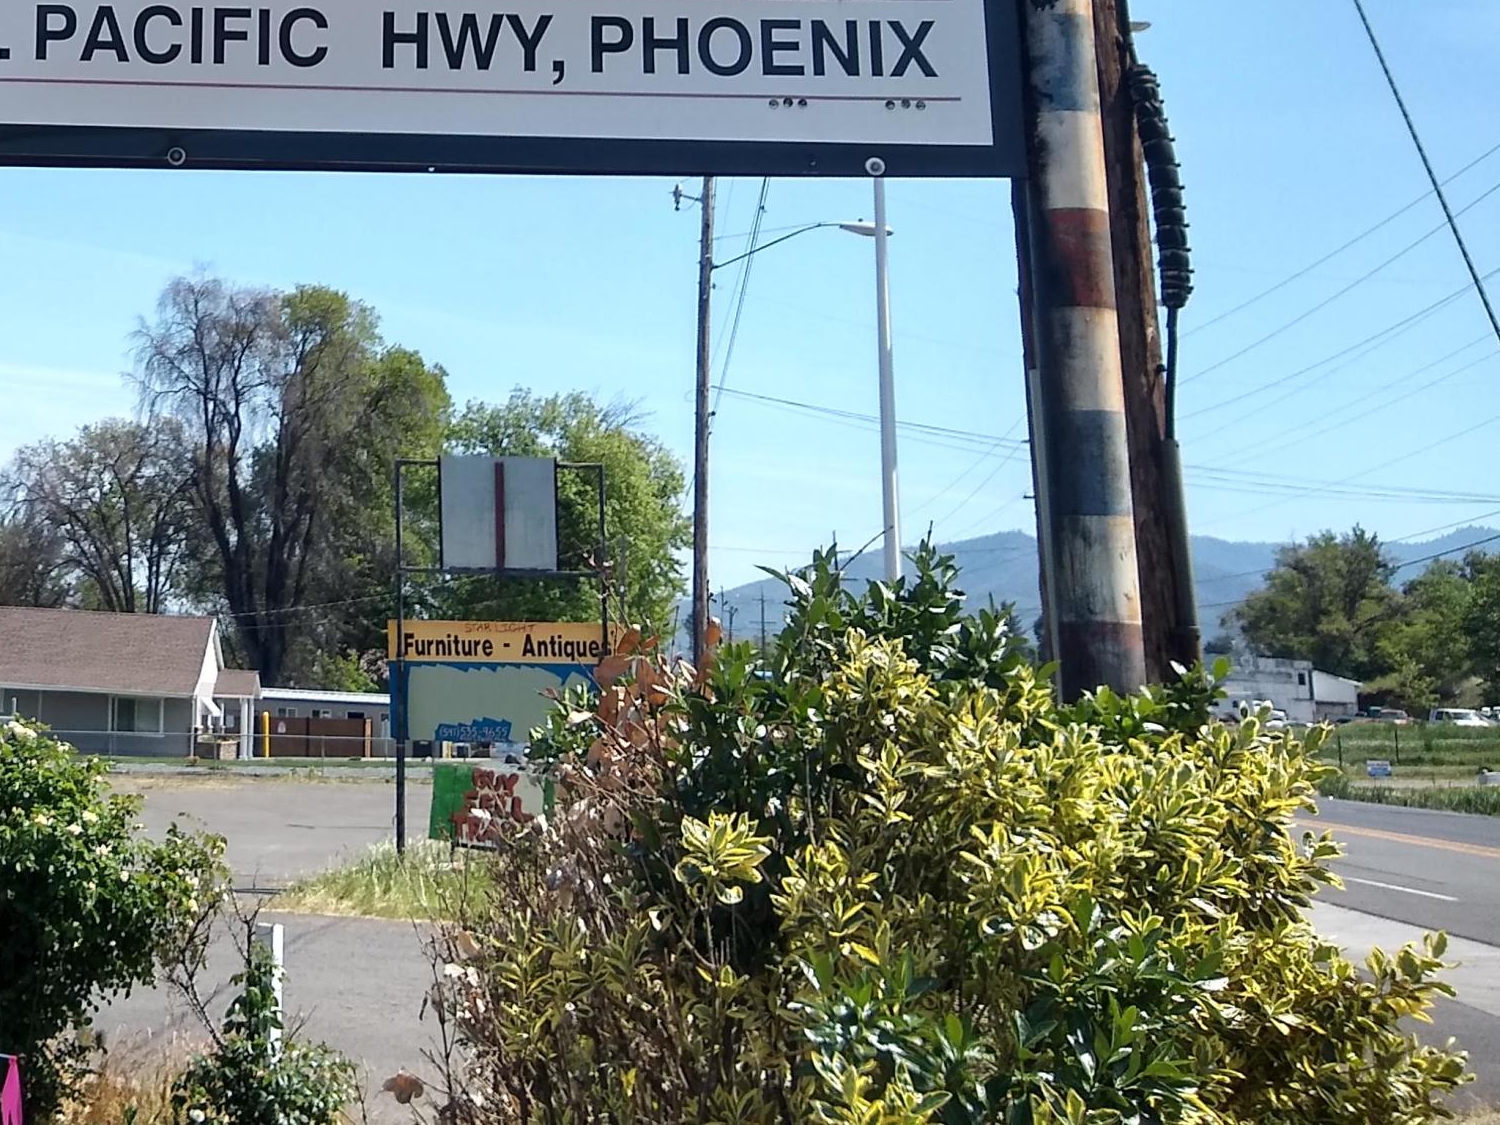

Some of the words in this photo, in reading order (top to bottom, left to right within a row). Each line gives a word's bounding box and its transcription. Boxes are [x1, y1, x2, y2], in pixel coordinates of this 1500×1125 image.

[35, 4, 330, 68] PACIFIC
[382, 10, 565, 86] HWY,
[590, 15, 939, 78] PHOENIX
[404, 632, 494, 657] Furniture
